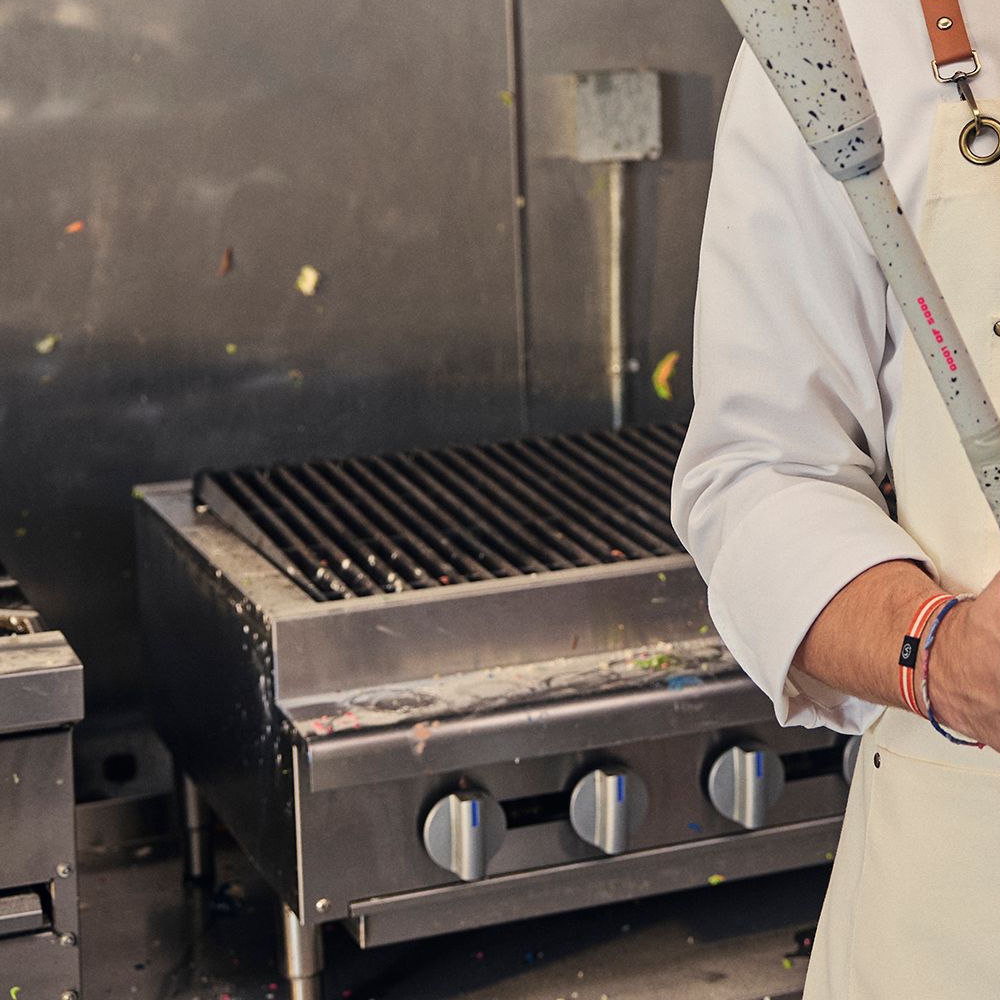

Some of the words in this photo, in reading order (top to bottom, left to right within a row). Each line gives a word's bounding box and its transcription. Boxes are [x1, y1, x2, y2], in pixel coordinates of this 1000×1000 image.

[917, 296, 935, 326] 5000
[932, 328, 944, 344] OF
[941, 346, 958, 372] 0001
